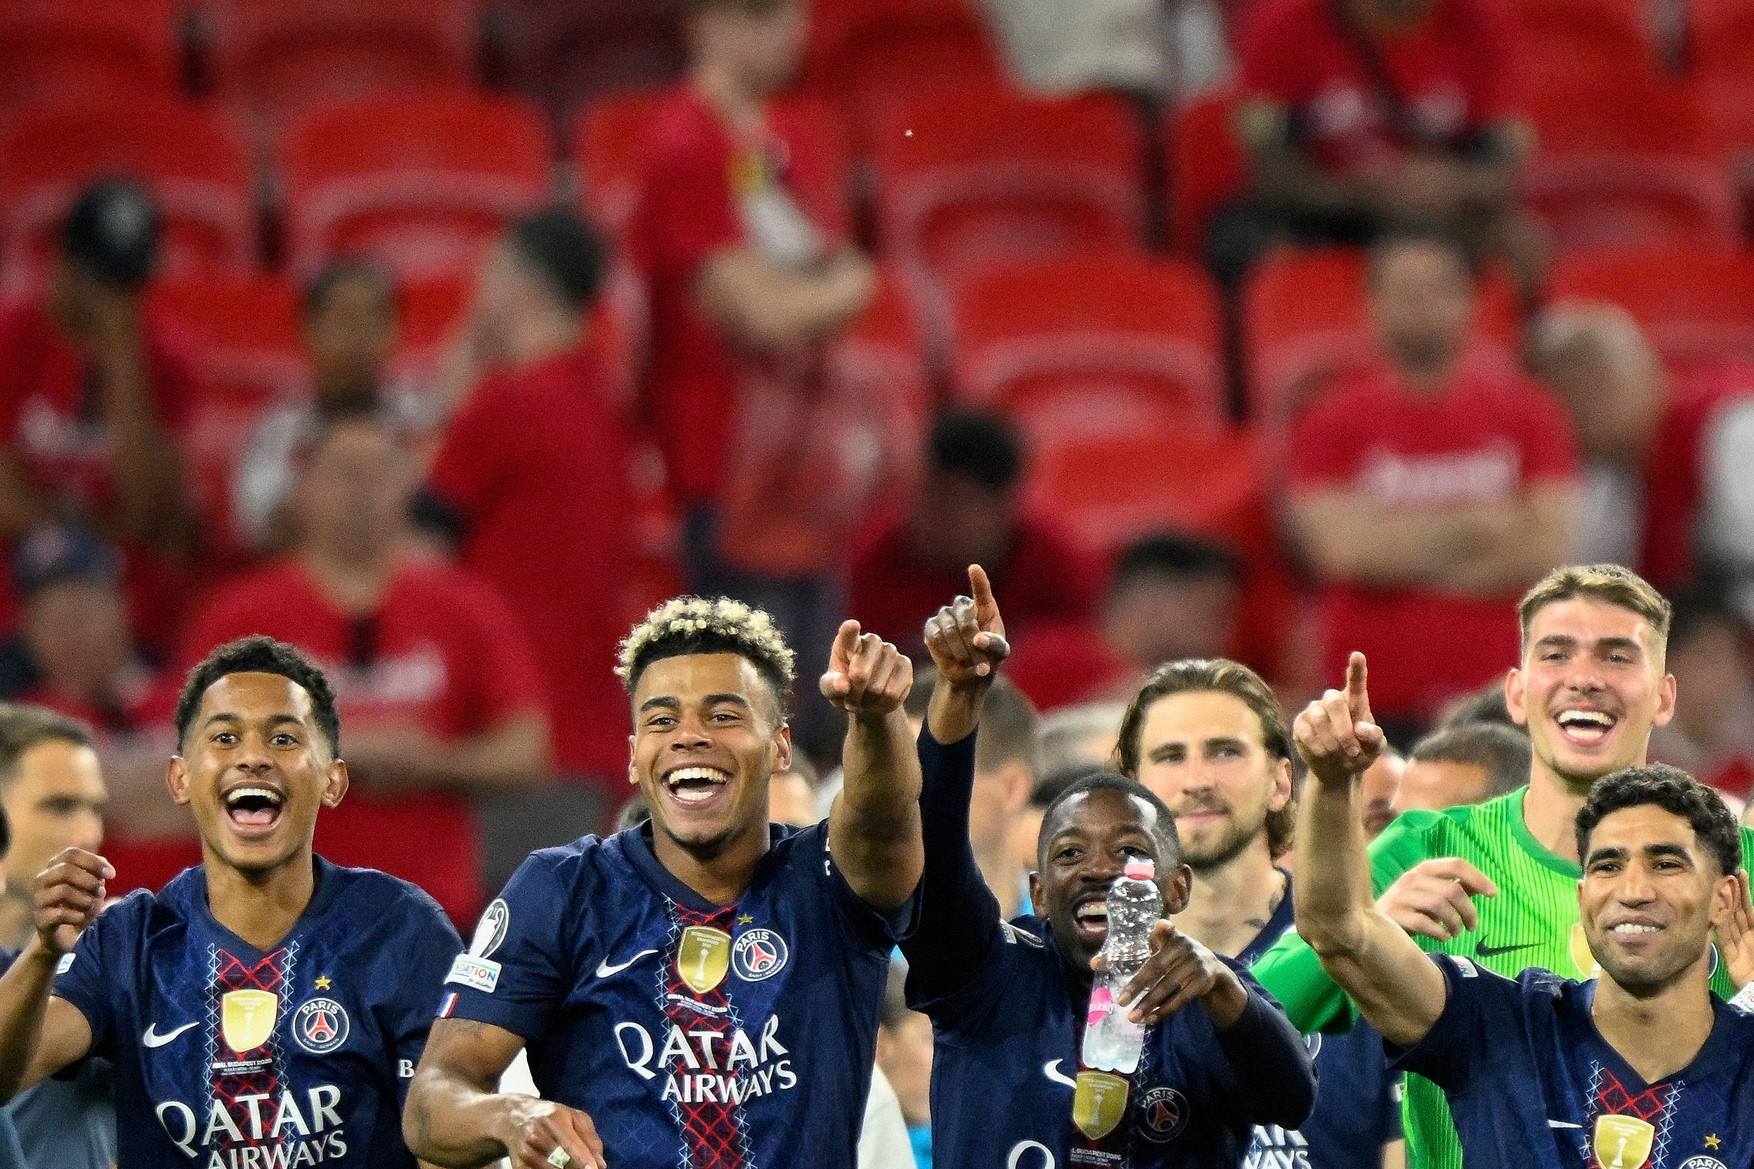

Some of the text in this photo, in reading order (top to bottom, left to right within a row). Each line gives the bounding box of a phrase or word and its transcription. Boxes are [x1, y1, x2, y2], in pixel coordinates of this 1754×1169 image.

[736, 931, 770, 953] PARIS
[301, 1001, 340, 1016] PARIS
[614, 1013, 789, 1080] QATAR
[661, 1059, 798, 1106] AIRWAYS
[156, 1084, 344, 1159] QATAR
